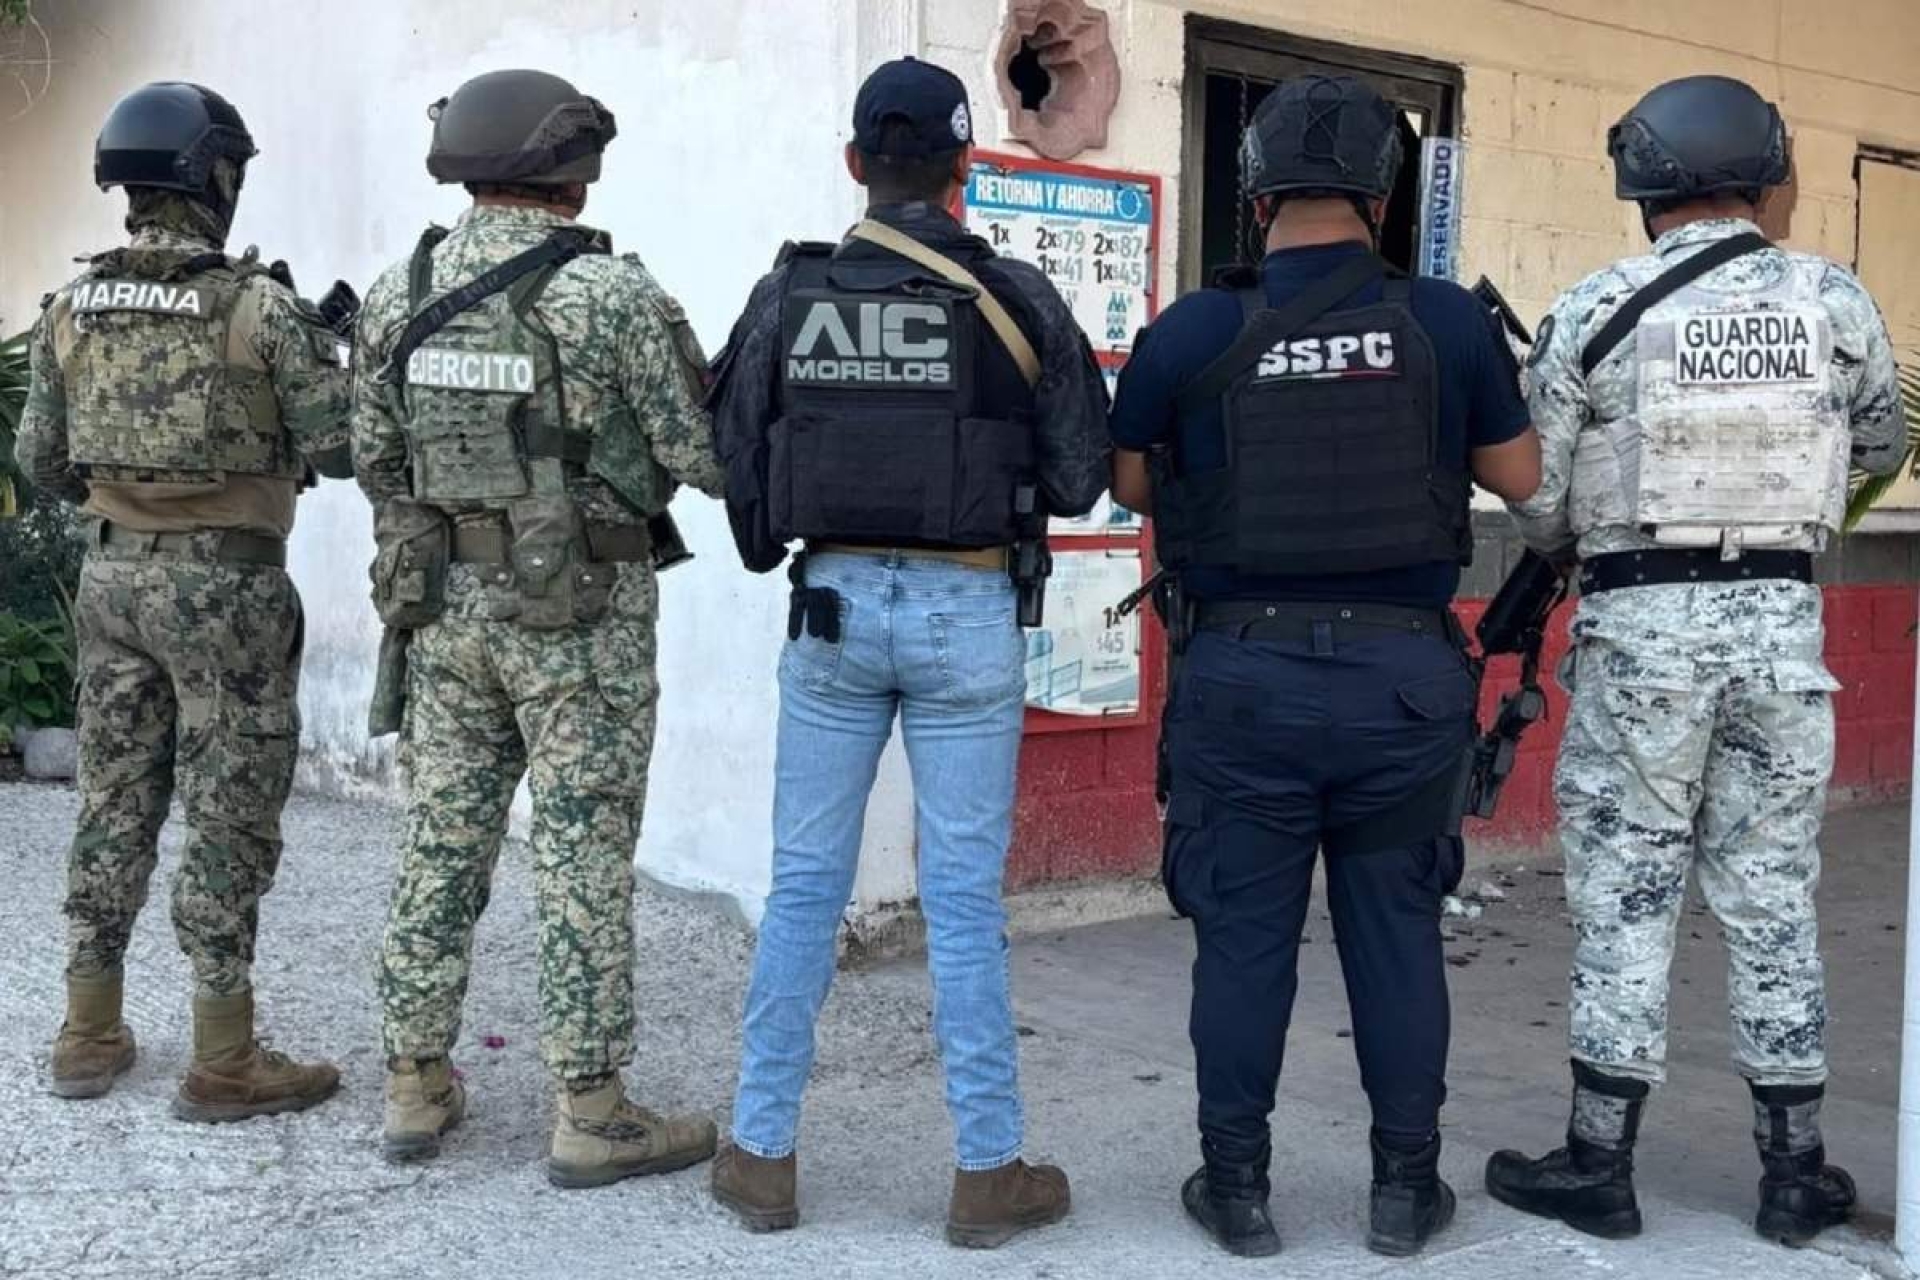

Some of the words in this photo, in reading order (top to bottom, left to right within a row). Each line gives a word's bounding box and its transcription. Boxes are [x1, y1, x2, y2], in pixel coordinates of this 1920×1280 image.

[975, 175, 1044, 208] RETORNA
[1045, 181, 1057, 210] Y
[1056, 184, 1115, 214] AHORRA
[1433, 145, 1452, 276] ESERVADO
[72, 282, 200, 314] MARINA
[790, 302, 948, 358] AIC
[1685, 315, 1809, 347] GUARDIA
[408, 352, 532, 391] EJERCITO
[788, 359, 950, 383] MORELOS
[1257, 331, 1395, 377] SSPC
[1679, 349, 1815, 380] NACIONAL
